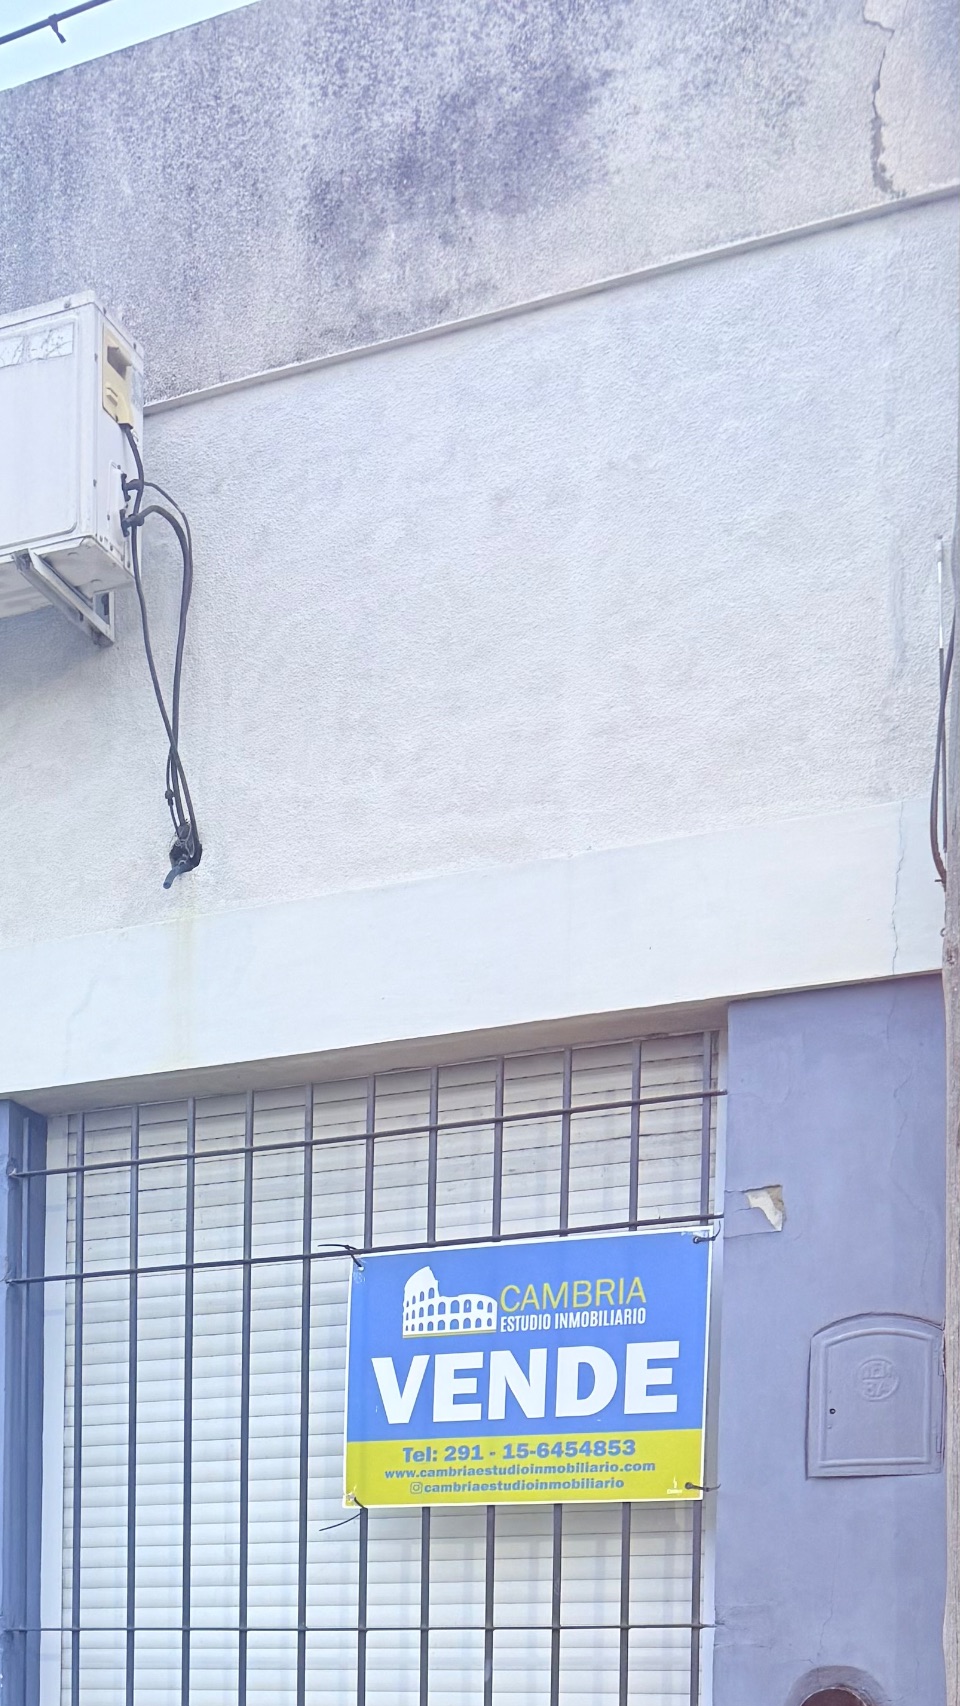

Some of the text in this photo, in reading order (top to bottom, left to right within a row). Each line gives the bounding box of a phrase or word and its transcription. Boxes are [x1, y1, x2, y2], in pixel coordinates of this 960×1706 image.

[500, 1276, 647, 1313] CAMBRIA
[500, 1307, 647, 1333] ESTUDIO INMOBILIARIO
[371, 1340, 680, 1425] VENDE
[402, 1445, 438, 1463] Tel:
[443, 1444, 484, 1462] 291
[502, 1439, 636, 1460] 15-6454853
[384, 1461, 657, 1479] www.cambriaestudioinmobiliario.com
